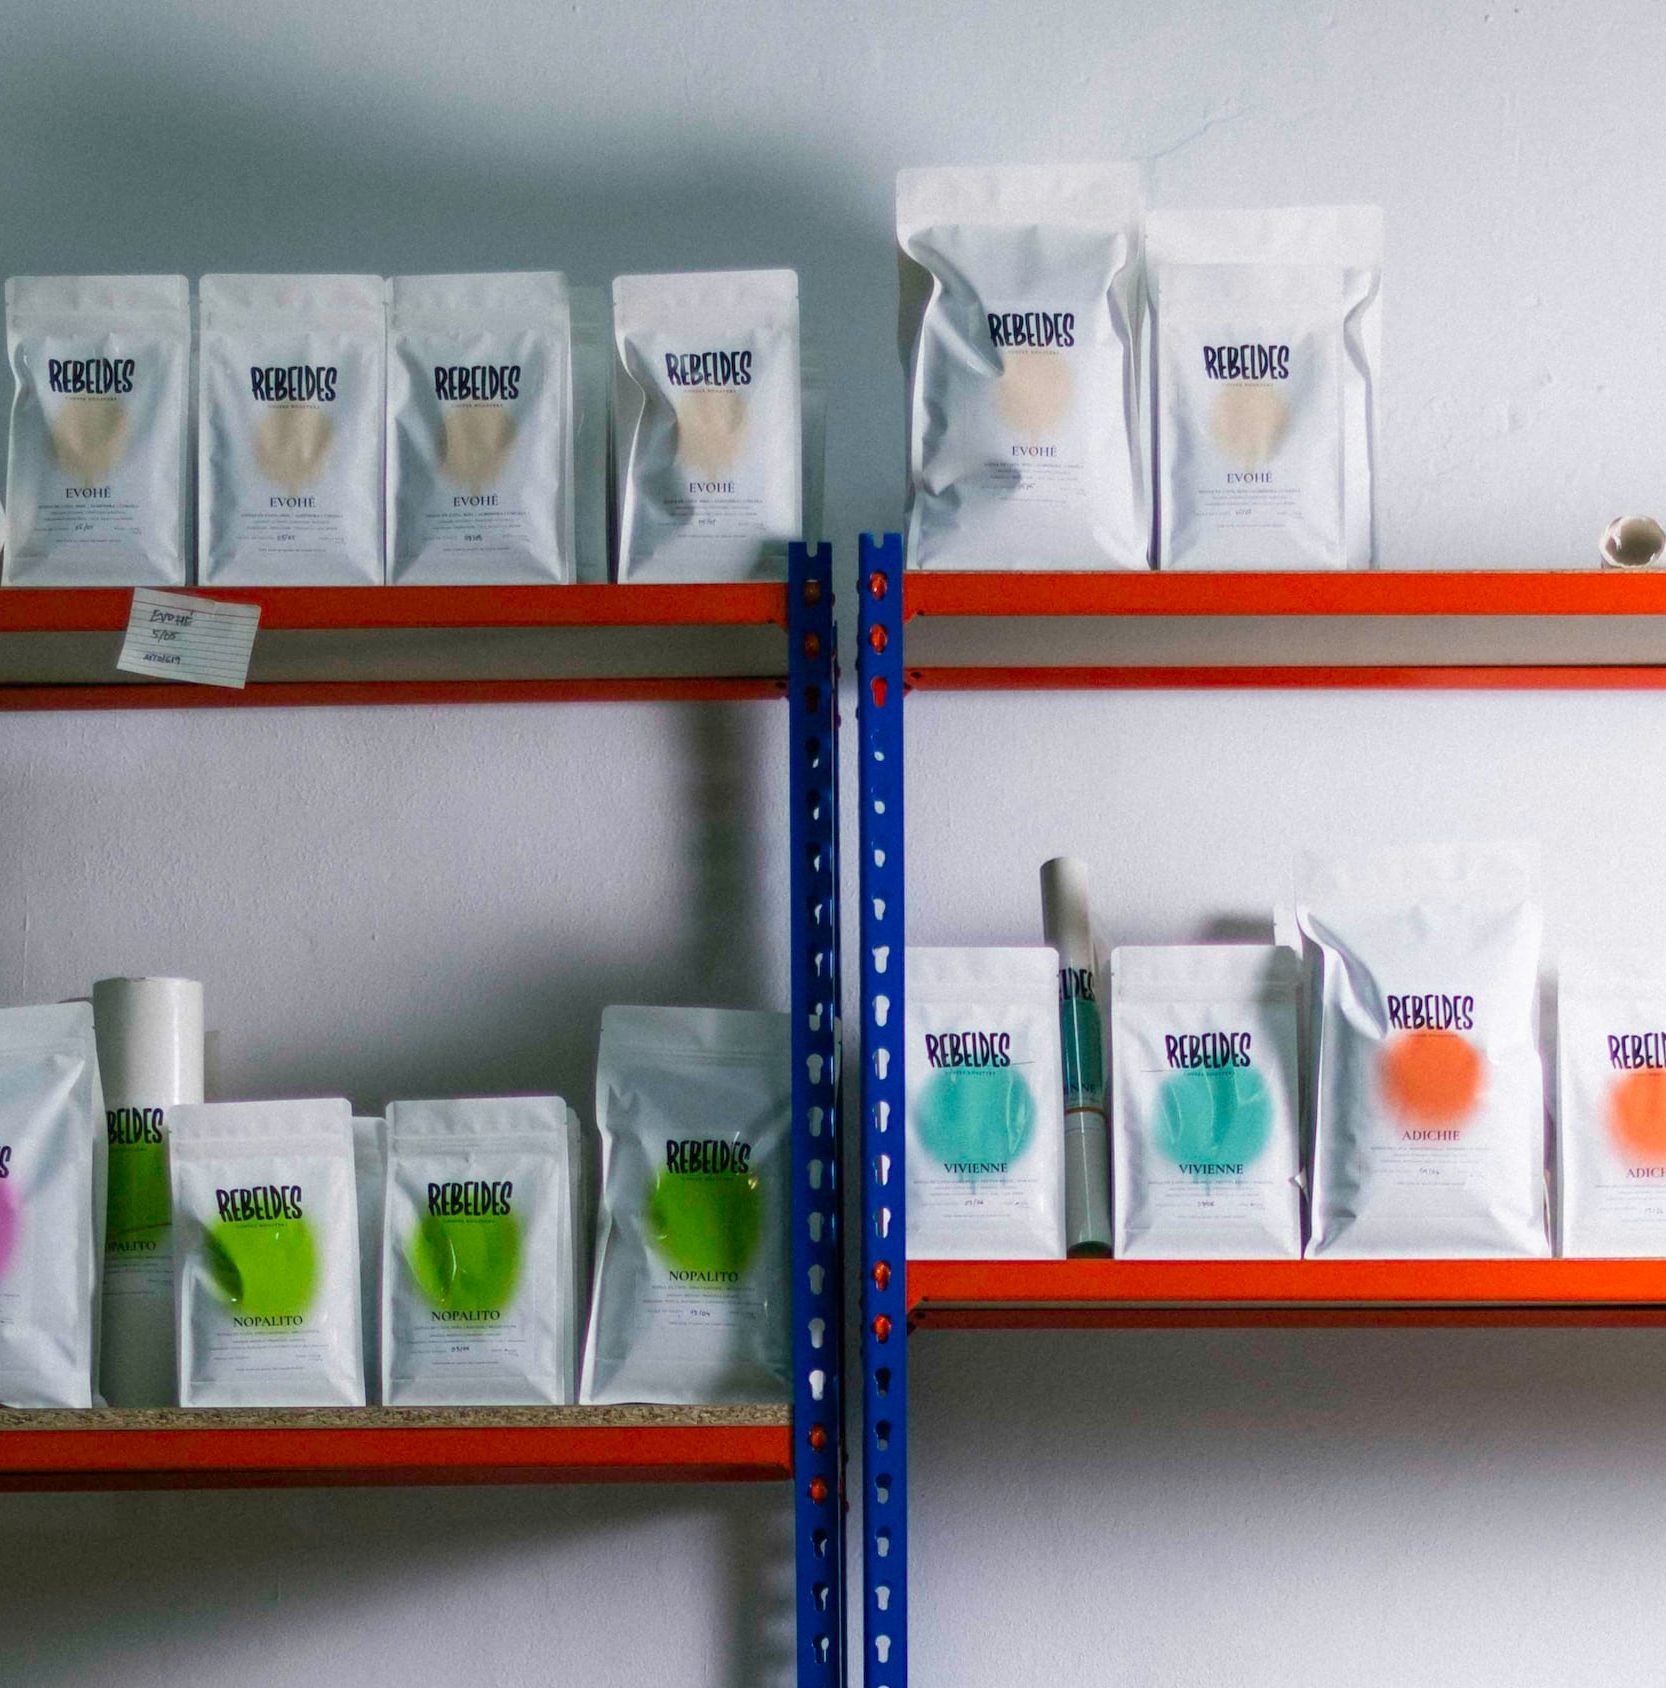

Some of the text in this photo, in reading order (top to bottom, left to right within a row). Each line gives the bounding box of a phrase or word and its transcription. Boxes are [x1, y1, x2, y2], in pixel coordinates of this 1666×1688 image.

[987, 312, 1075, 347] REBELDES
[49, 358, 135, 394] REBELDES
[665, 350, 752, 386] REBELDES
[1203, 344, 1290, 380] REBELDES
[250, 366, 337, 402] REBELDES
[435, 365, 520, 400] REBELDES
[1012, 445, 1057, 457] EVOHÉ
[66, 486, 111, 499] EVOHÉ
[689, 480, 735, 493] EVOHÉ
[1227, 471, 1273, 483] EVOHÉ
[270, 495, 315, 508] EVOHÉ
[453, 494, 498, 507] EVOHÉ
[1059, 967, 1095, 1001] LDES
[1388, 994, 1474, 1030] REBELDES
[925, 1031, 1010, 1068] REBELDES
[1165, 1031, 1251, 1069] REBELDES
[107, 1107, 164, 1144] BELDES
[1402, 1130, 1460, 1141] ADICHIE
[666, 1139, 751, 1174] REBELDES
[944, 1162, 1008, 1174] VIVIENNE
[1179, 1163, 1244, 1175] VIVIENNE
[216, 1185, 303, 1222] REBELDES
[428, 1181, 513, 1216] REBELDES
[107, 1241, 156, 1251] PALITO
[669, 1270, 738, 1282] NOPALITO
[233, 1315, 303, 1328] NOPALITO
[431, 1310, 500, 1321] NOPALITO
